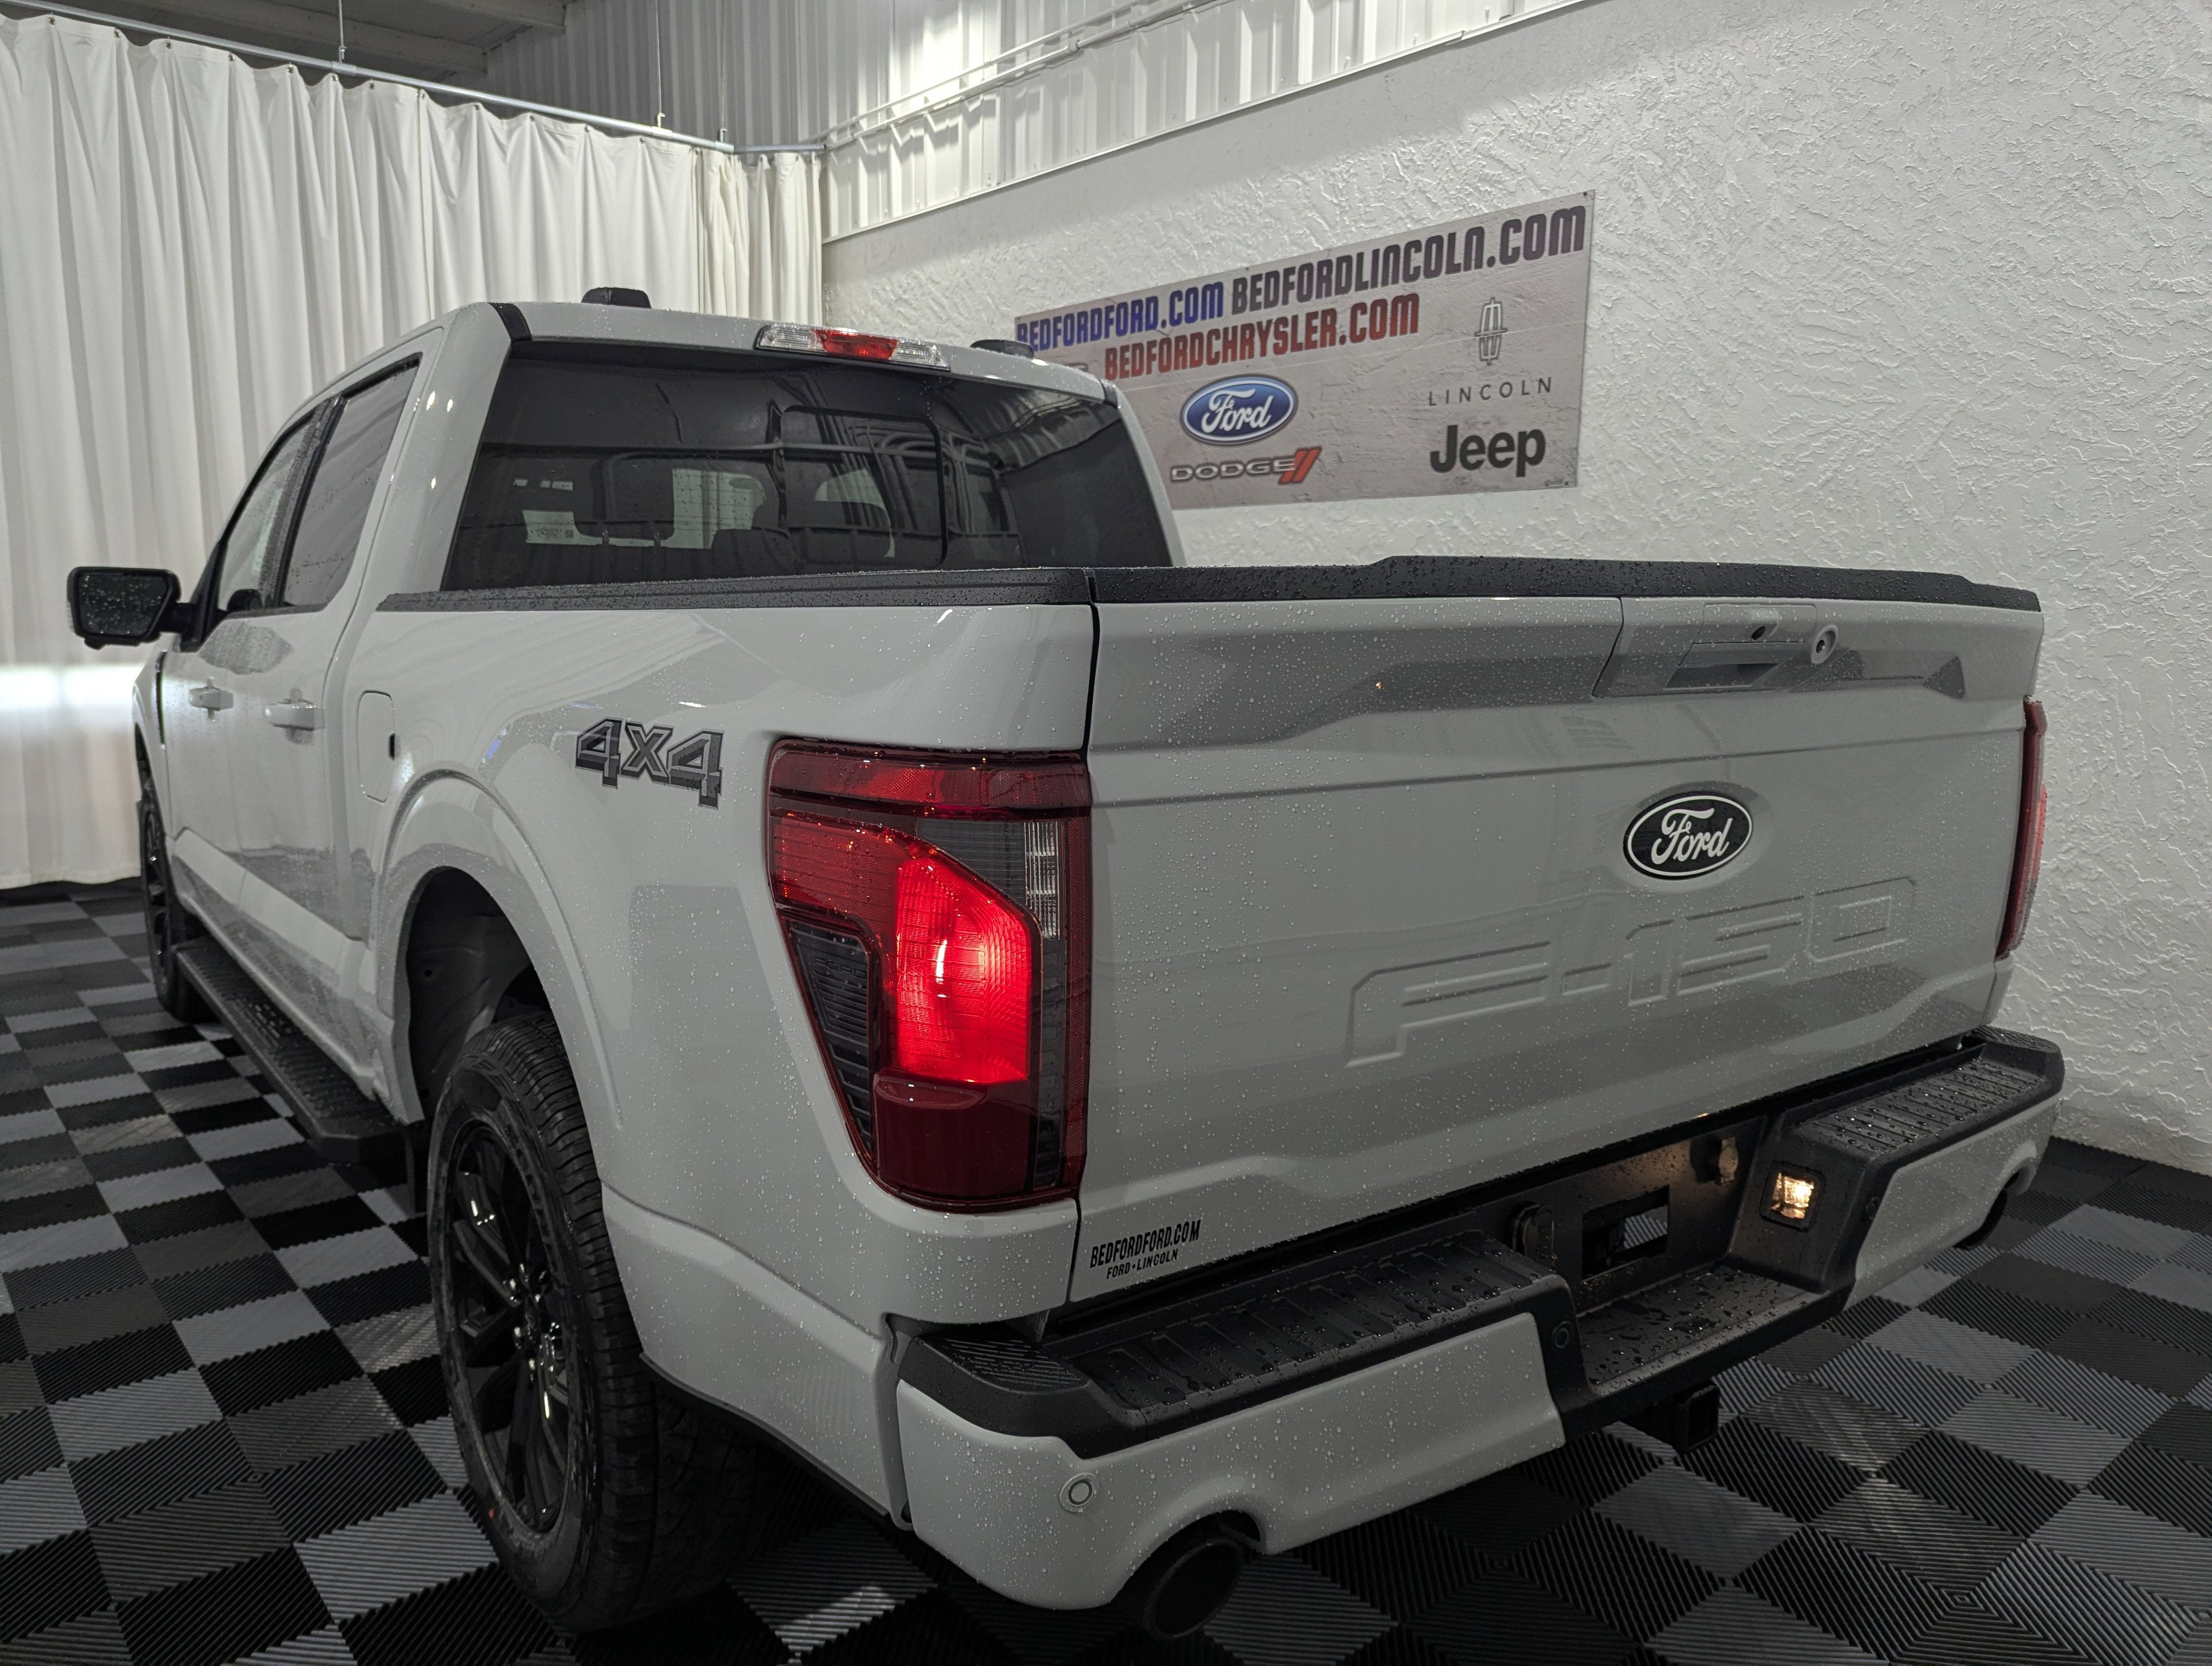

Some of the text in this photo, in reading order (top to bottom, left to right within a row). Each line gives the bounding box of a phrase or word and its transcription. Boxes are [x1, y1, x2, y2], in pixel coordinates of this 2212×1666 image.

[1232, 205, 1586, 315] BEDFORDLINCOLN.COM
[1104, 292, 1420, 381] BEDFORDCHRYSLER.COM
[1201, 388, 1274, 434] Ford
[1427, 377, 1552, 407] LINCOLN
[1171, 456, 1298, 482] DODGE
[1430, 424, 1546, 478] Jeep
[1650, 805, 1734, 865] Ford
[1345, 875, 1917, 1068] F-150
[1090, 1219, 1201, 1268] BEDFORDFORD.COM
